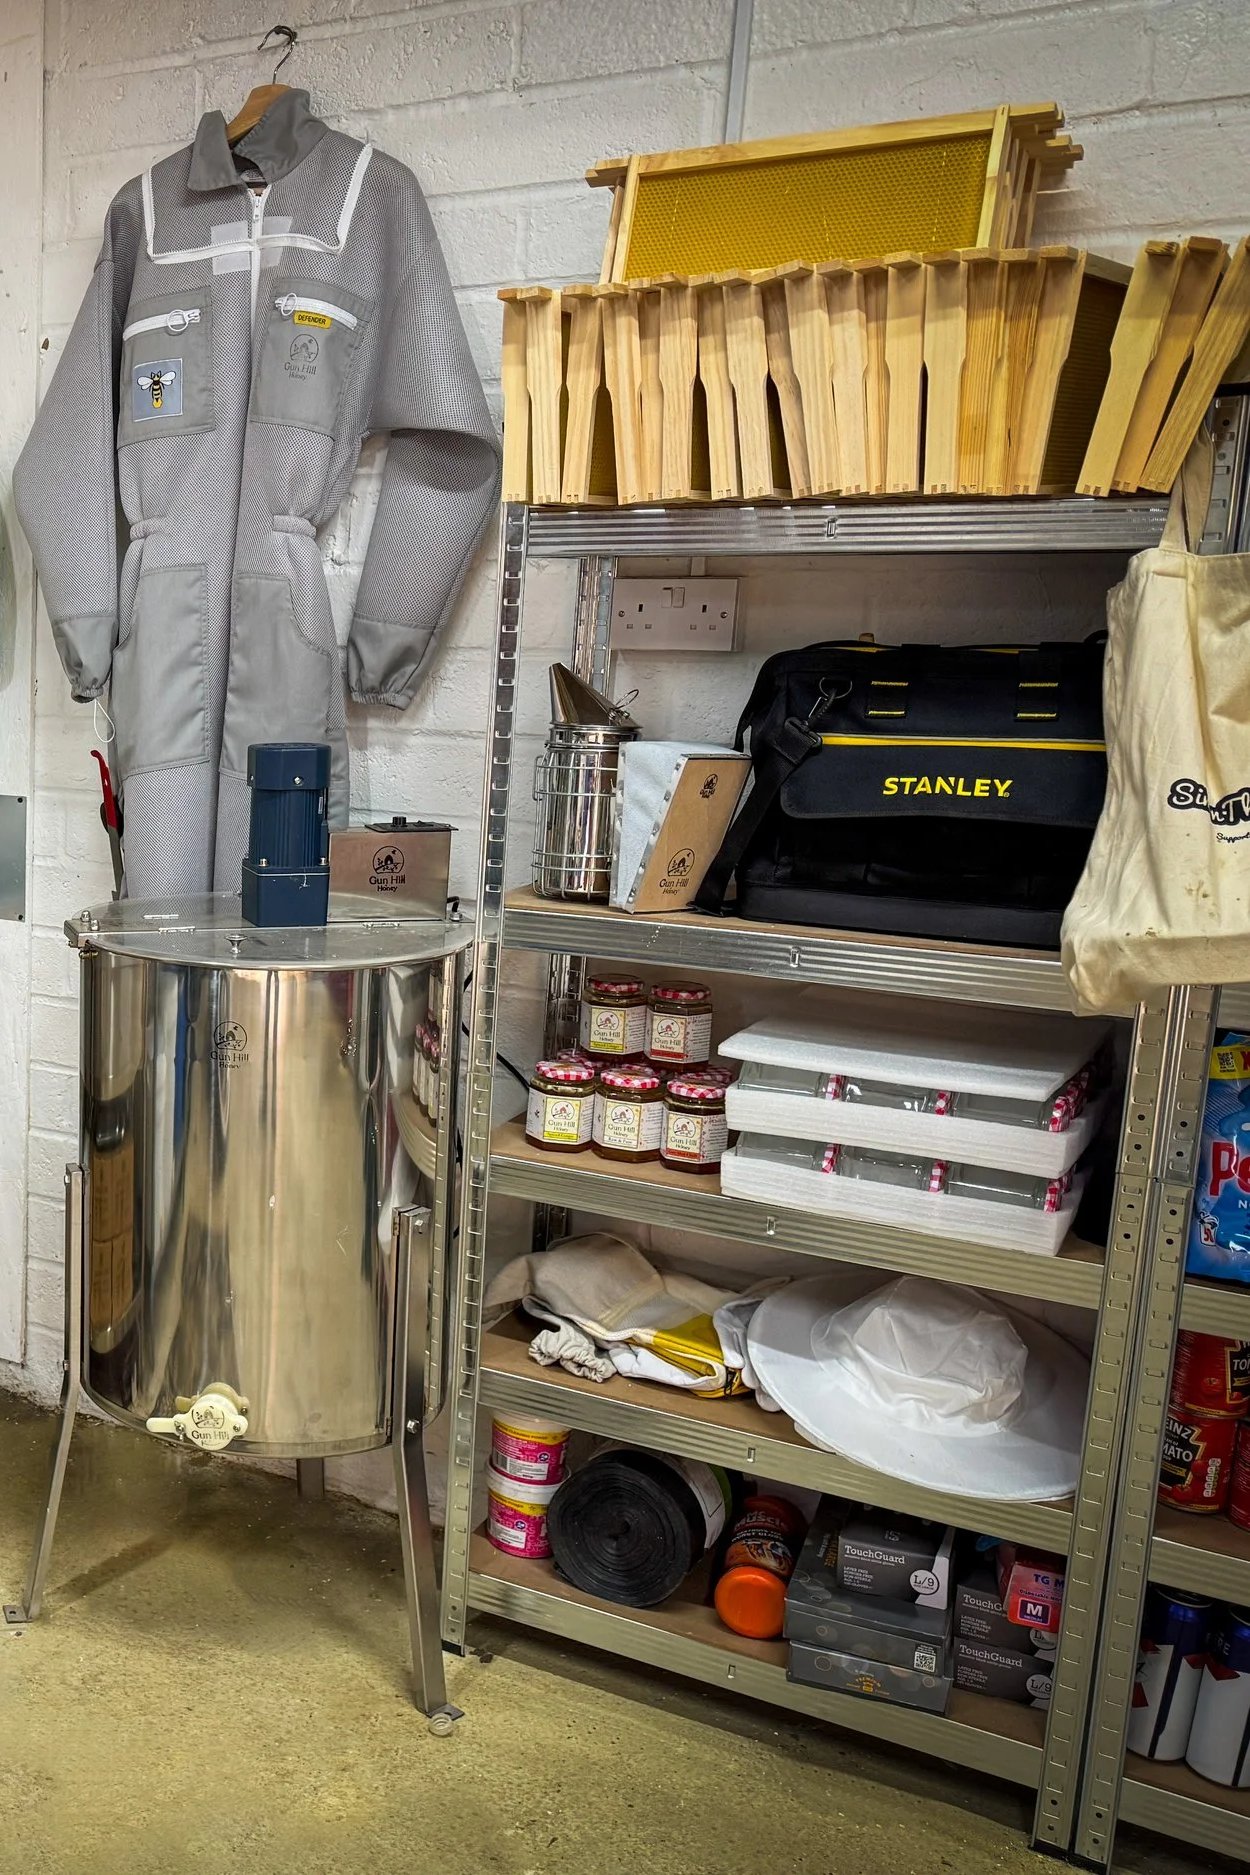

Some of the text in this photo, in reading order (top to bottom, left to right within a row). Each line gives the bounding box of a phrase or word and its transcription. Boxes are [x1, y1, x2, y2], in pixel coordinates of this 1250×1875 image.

[298, 314, 327, 325] DEFENDER
[882, 776, 1013, 797] STANLEY
[369, 874, 406, 885] Gun Hill
[659, 878, 689, 888] Gun Hill
[377, 885, 398, 893] Honey
[211, 1051, 249, 1062] Gun Hill
[191, 1430, 211, 1439] Gun
[1165, 1418, 1192, 1440] EINZ
[1163, 1443, 1193, 1463] MATO
[844, 1544, 905, 1564] TouchGuard
[913, 1574, 935, 1587] L/9
[1033, 1573, 1049, 1585] TG
[963, 1594, 1003, 1611] TouchG
[1026, 1603, 1043, 1617] M
[959, 1644, 1022, 1667] TouchGuard
